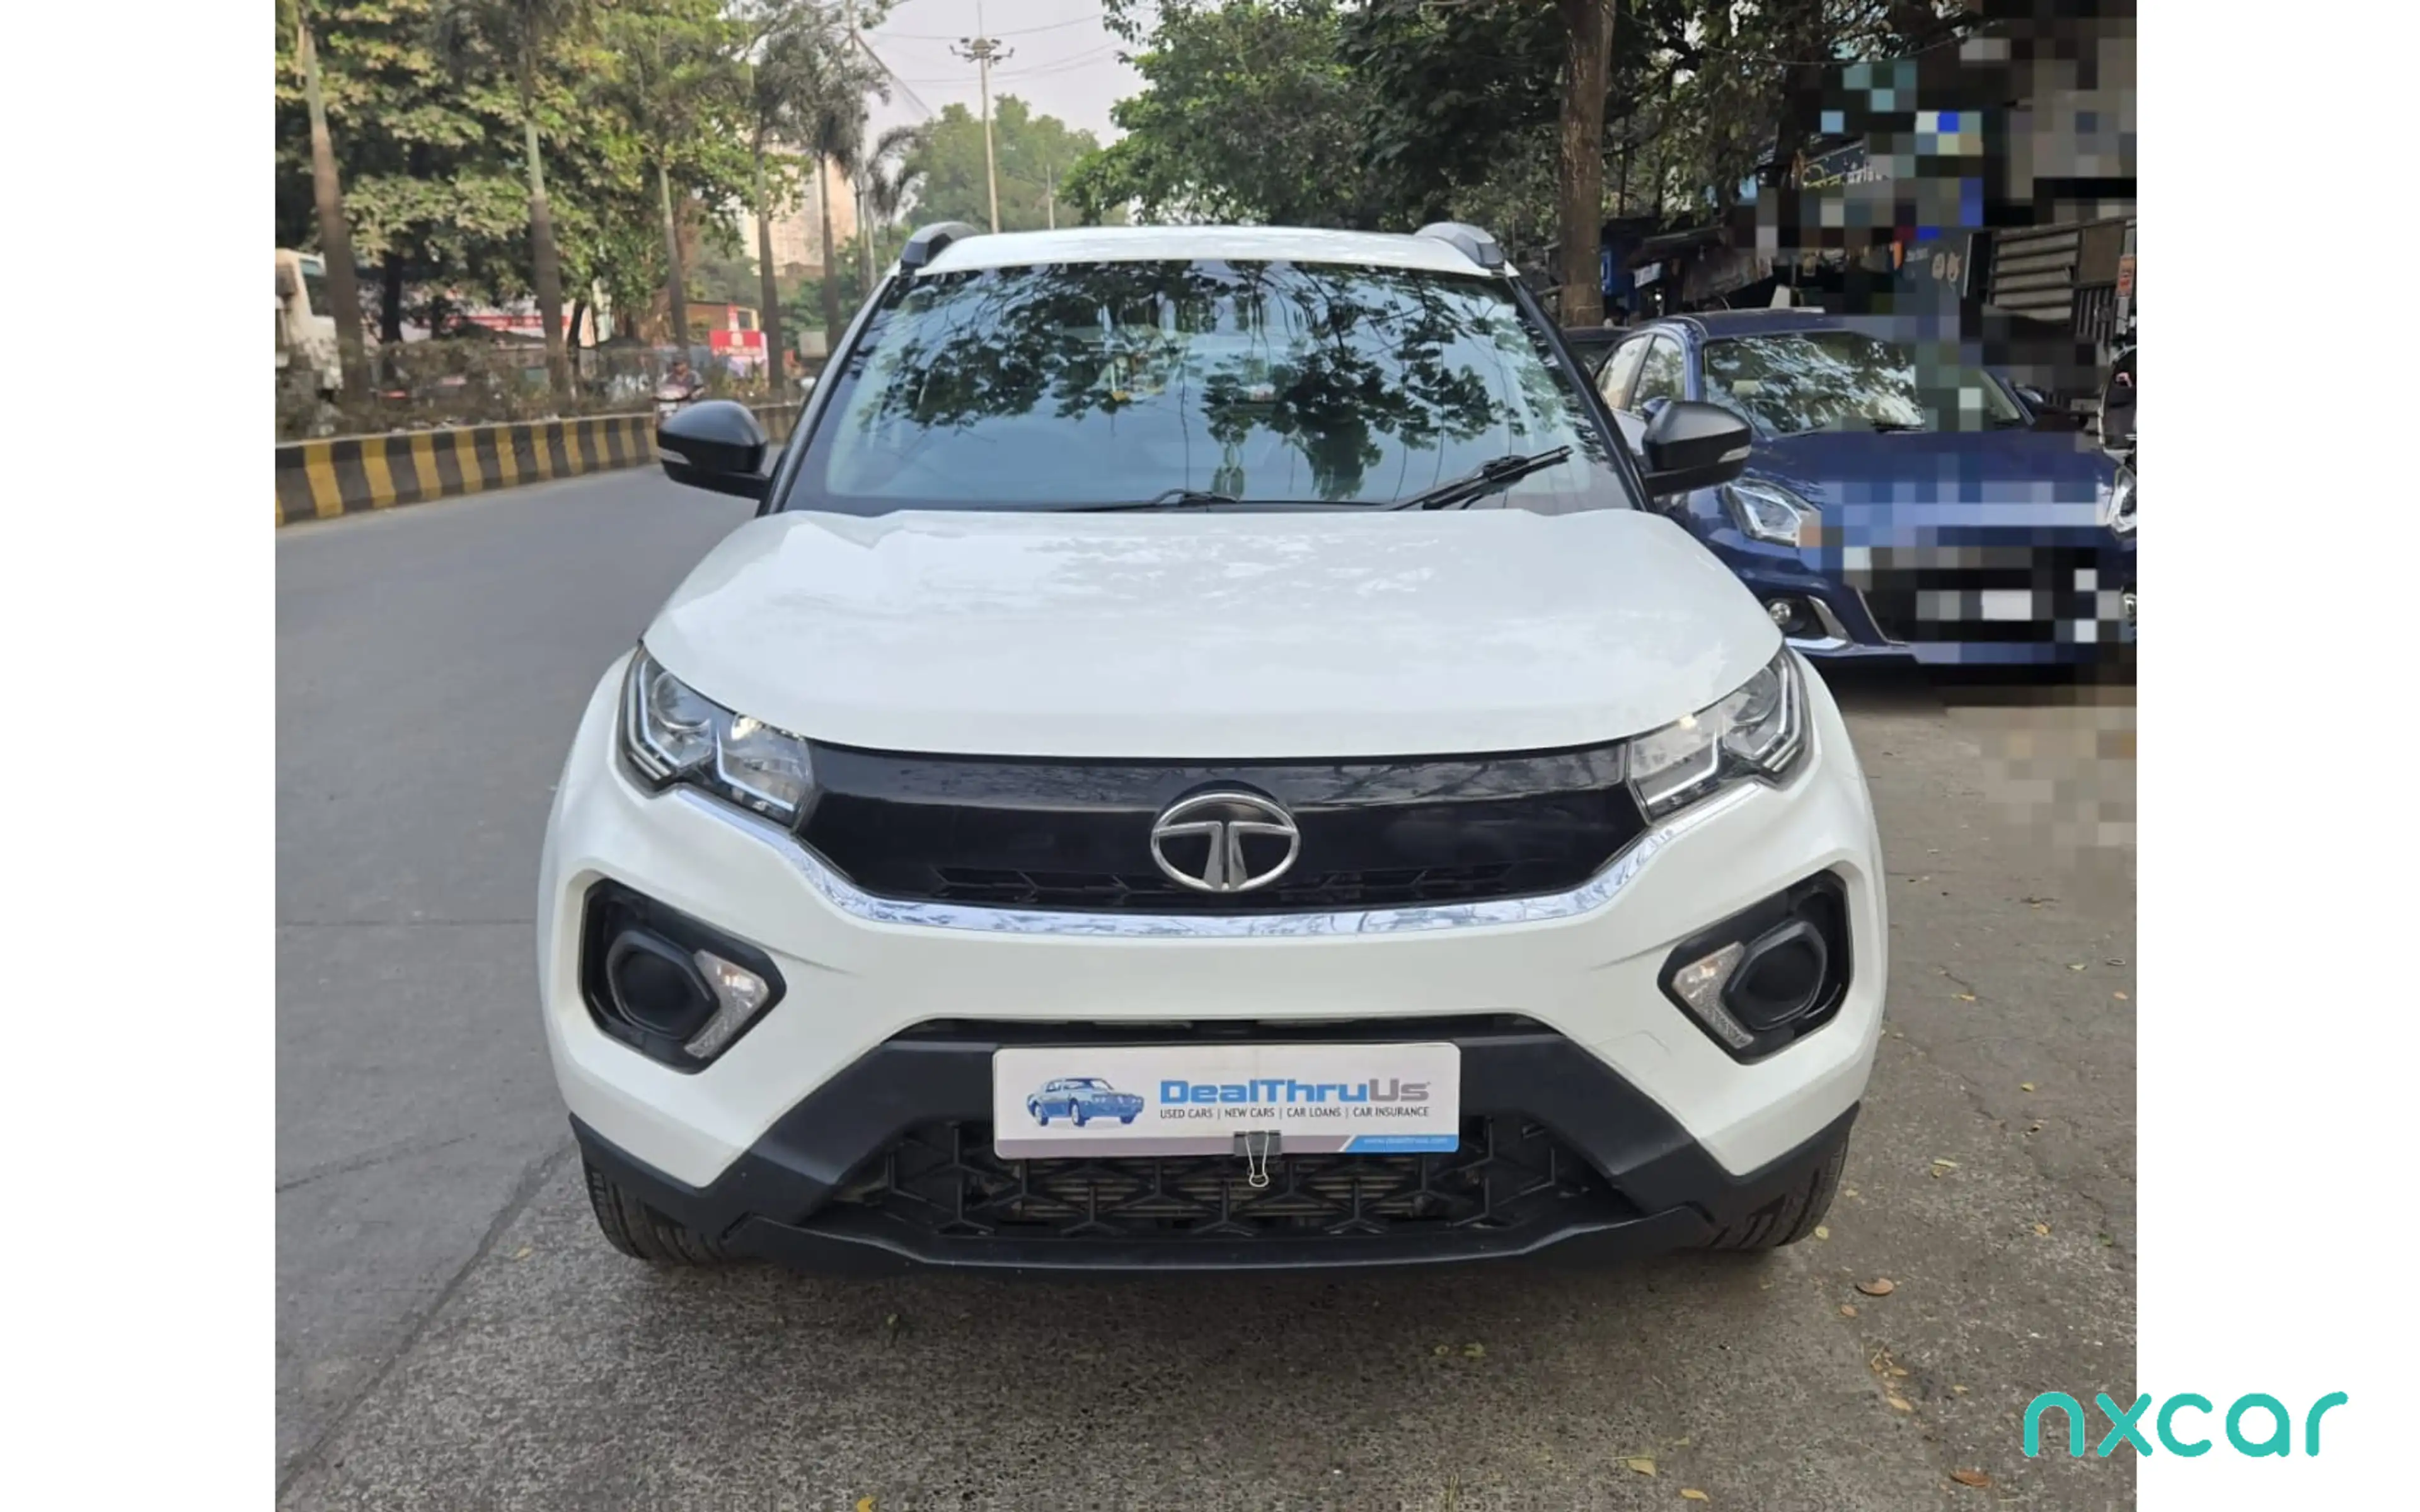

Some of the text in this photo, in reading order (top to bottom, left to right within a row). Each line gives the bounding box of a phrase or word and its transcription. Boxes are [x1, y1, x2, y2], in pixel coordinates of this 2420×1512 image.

[1161, 1079, 1431, 1104] DealThruUs
[1160, 1106, 1429, 1119] USED CARS NEW CARS CAR LOANS CAR INSURANCE
